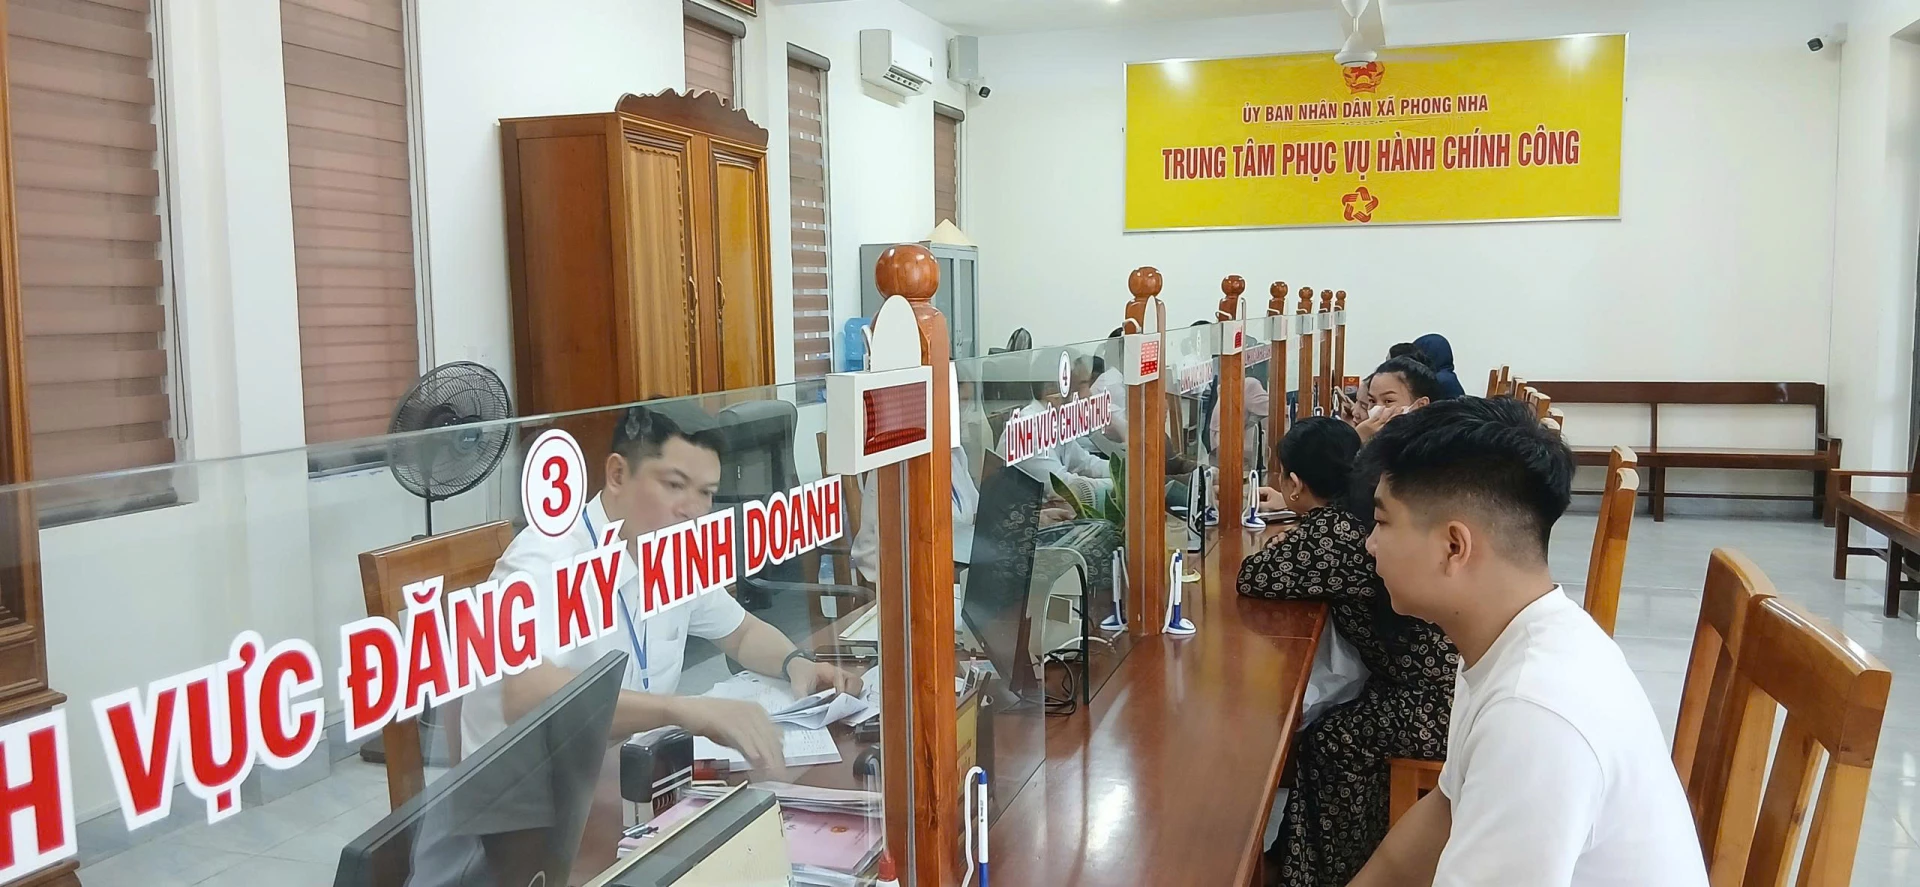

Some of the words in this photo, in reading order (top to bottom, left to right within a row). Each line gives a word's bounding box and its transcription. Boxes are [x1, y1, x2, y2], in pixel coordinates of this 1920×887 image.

[1242, 101, 1261, 123] ỦY
[1265, 104, 1293, 122] BAN
[1298, 100, 1338, 120] NHÂN
[1343, 98, 1372, 118] DÂN
[1376, 96, 1395, 116] XÃ
[1400, 96, 1451, 115] PHONG
[1457, 94, 1488, 113] NHA
[1162, 146, 1227, 180] TRUNG
[1232, 138, 1275, 177] TÂM
[1282, 141, 1337, 181] PHỤC
[1343, 140, 1370, 180] VỤ
[1376, 131, 1436, 172] HÀNH
[1442, 128, 1511, 170] CHÍNH
[1517, 124, 1580, 167] CÔNG
[1006, 411, 1034, 464] LĨNH
[1036, 402, 1058, 457] VỰC
[1059, 394, 1089, 443] CHỨNG
[1090, 389, 1112, 433] THỰC
[540, 455, 573, 518] 3
[105, 641, 318, 813] VỰC
[346, 580, 537, 731] ĐĂNG
[556, 527, 621, 648] KÝ
[642, 518, 734, 613] KINH
[747, 480, 841, 571] DOANH
